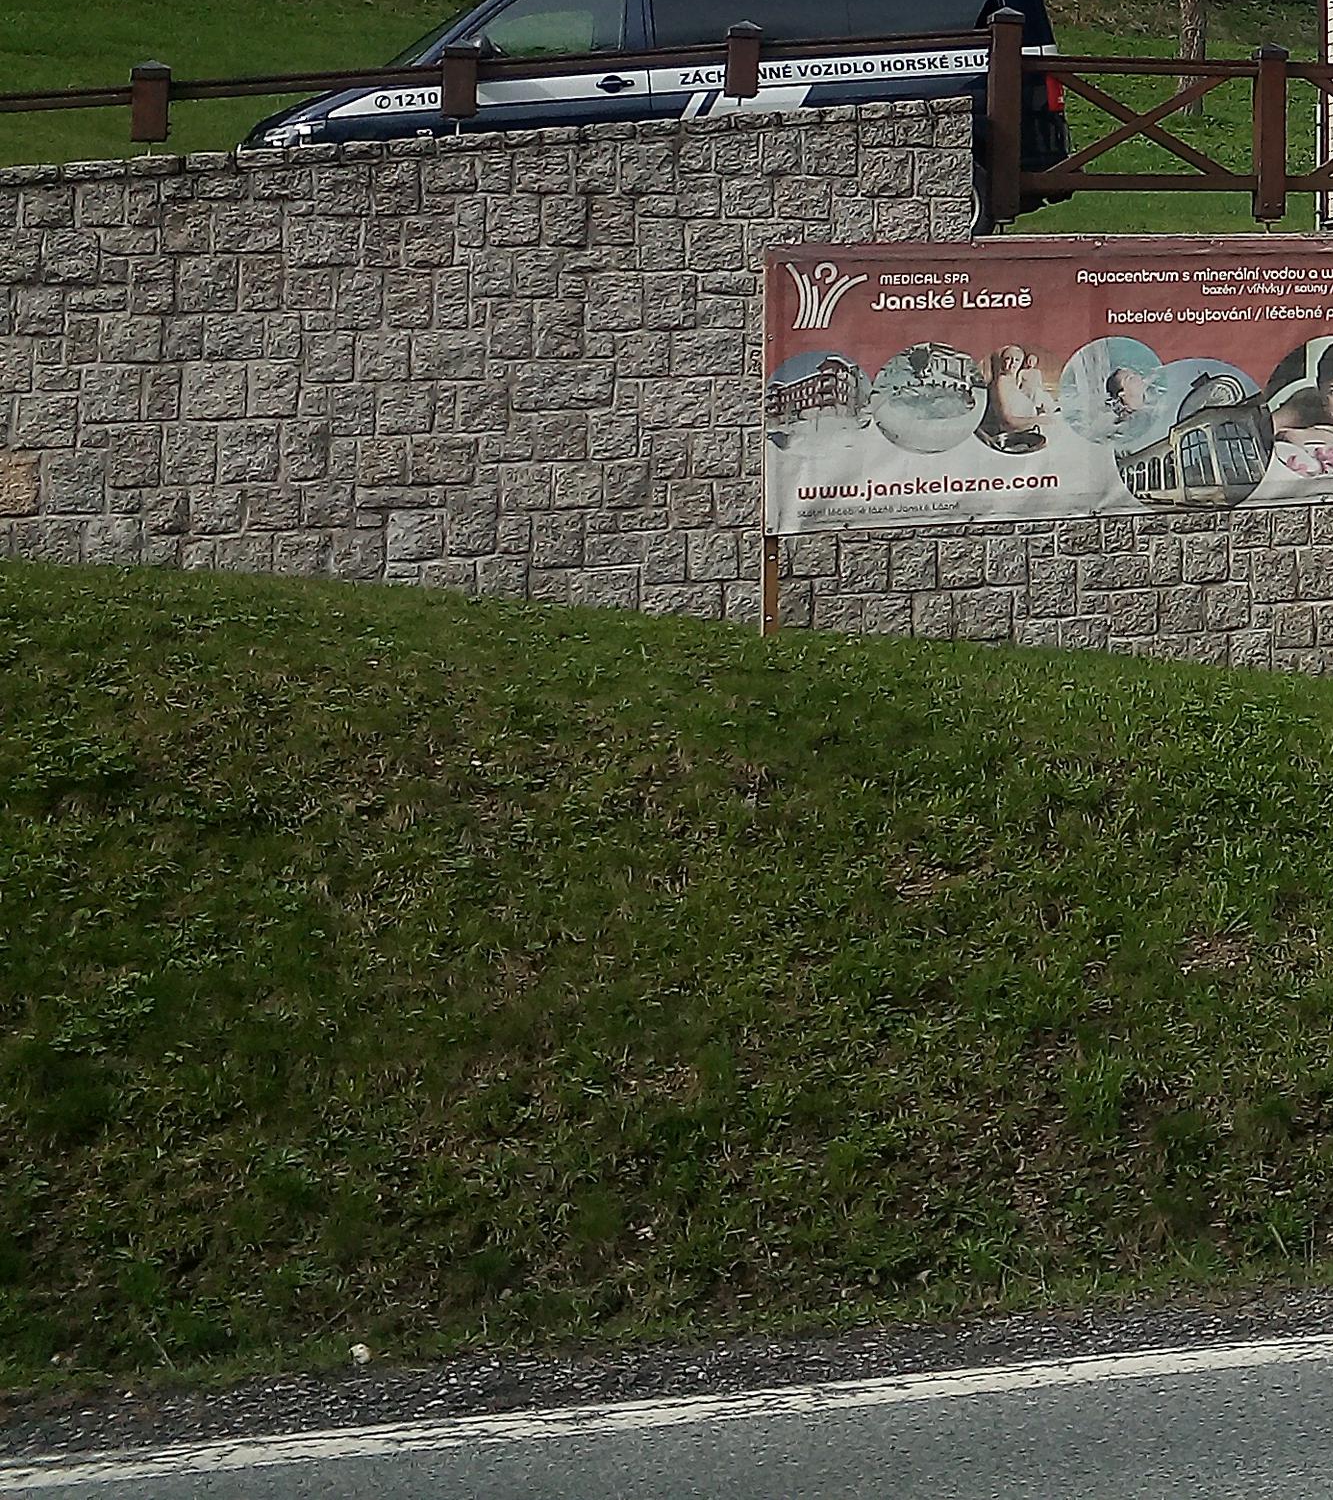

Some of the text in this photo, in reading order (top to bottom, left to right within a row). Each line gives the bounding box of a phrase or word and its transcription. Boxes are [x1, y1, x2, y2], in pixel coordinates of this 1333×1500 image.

[679, 63, 793, 87] ZÁCHNNÉ
[797, 60, 876, 78] VOZIDLO
[880, 53, 950, 73] HORSKÉ
[394, 92, 438, 107] 1210
[879, 273, 970, 285] MEDICAL SPA
[1076, 269, 1179, 286] Aquacentrum
[1182, 272, 1190, 282] s
[1193, 268, 1260, 282] minerální
[1262, 267, 1305, 280] vodou
[1308, 270, 1318, 279] a
[1201, 283, 1236, 295] bazén
[1294, 283, 1328, 295] sauny
[870, 288, 1032, 311] Janské Lázně
[1107, 308, 1173, 323] hotelové
[1177, 306, 1252, 324] ubytování
[1265, 305, 1323, 321] léčebné
[797, 475, 1060, 502] www.janskelazne.com
